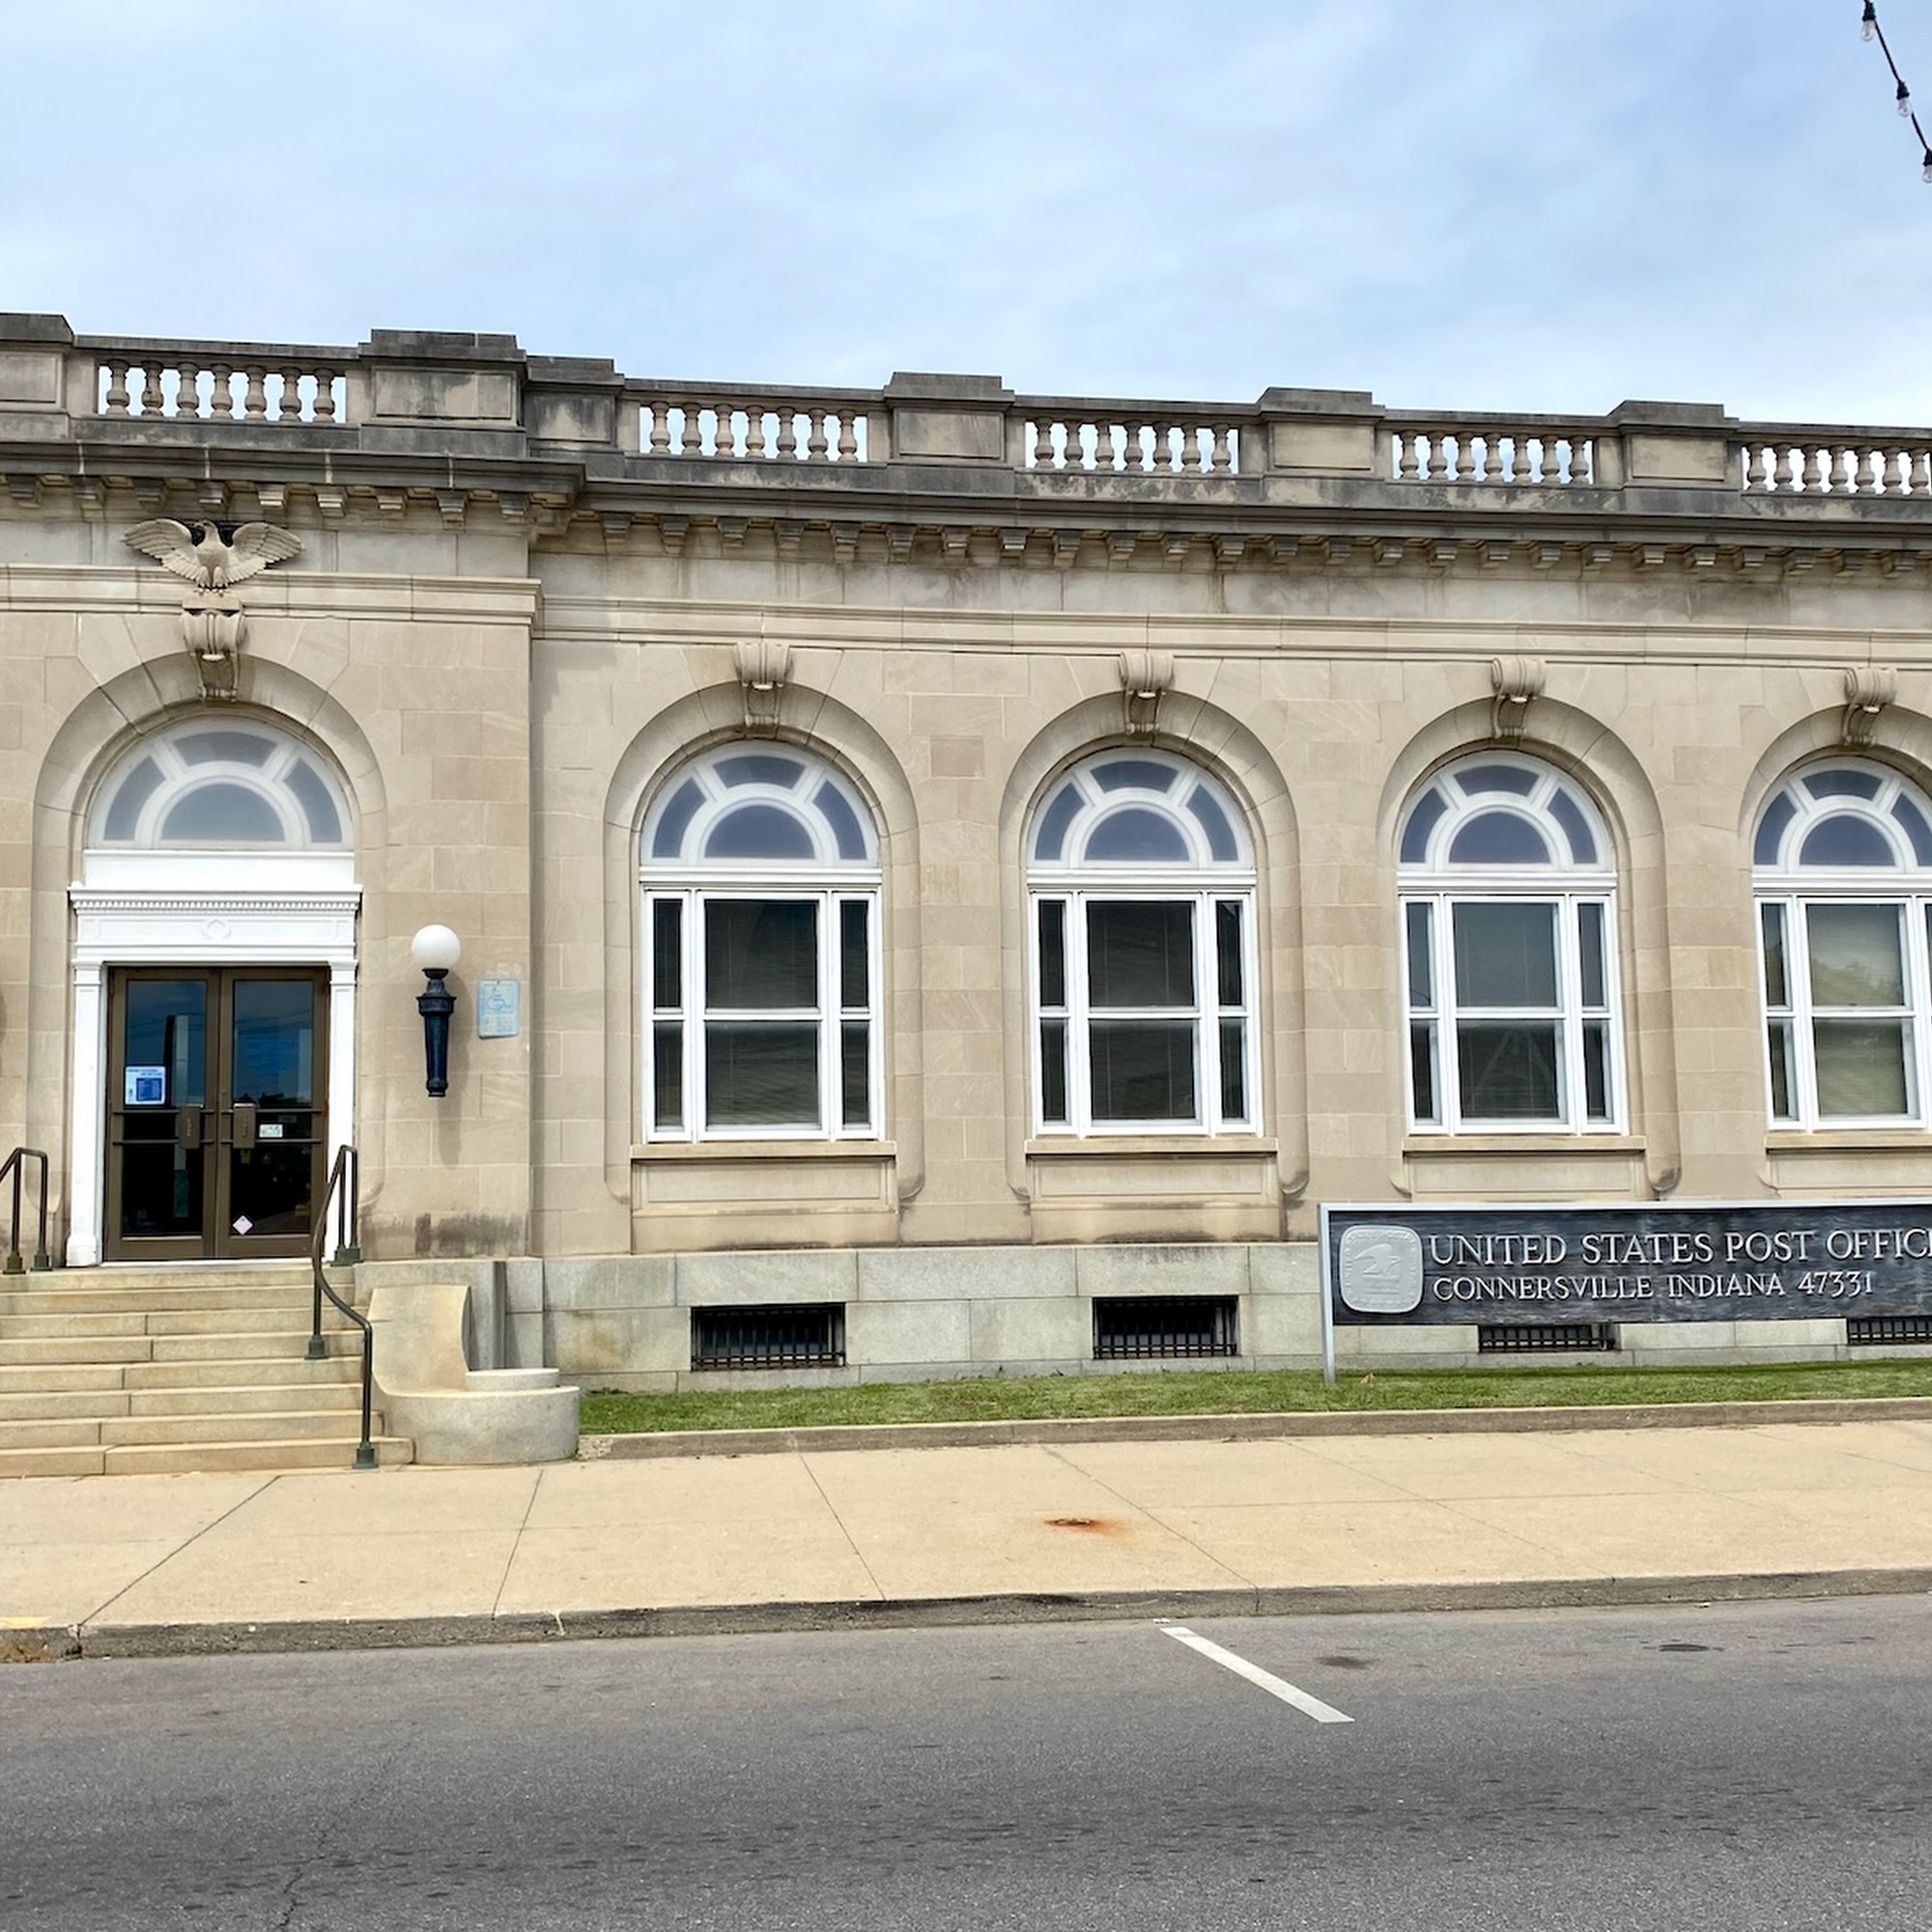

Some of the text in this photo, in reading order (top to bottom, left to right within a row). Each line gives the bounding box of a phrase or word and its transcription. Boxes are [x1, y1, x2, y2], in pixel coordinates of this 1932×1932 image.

[1429, 1234, 1567, 1264] UNITED
[1581, 1232, 1714, 1264] STATES
[1724, 1230, 1816, 1262] POST
[1434, 1269, 1874, 1300] CONNERSVILLE INDIANA 47331
